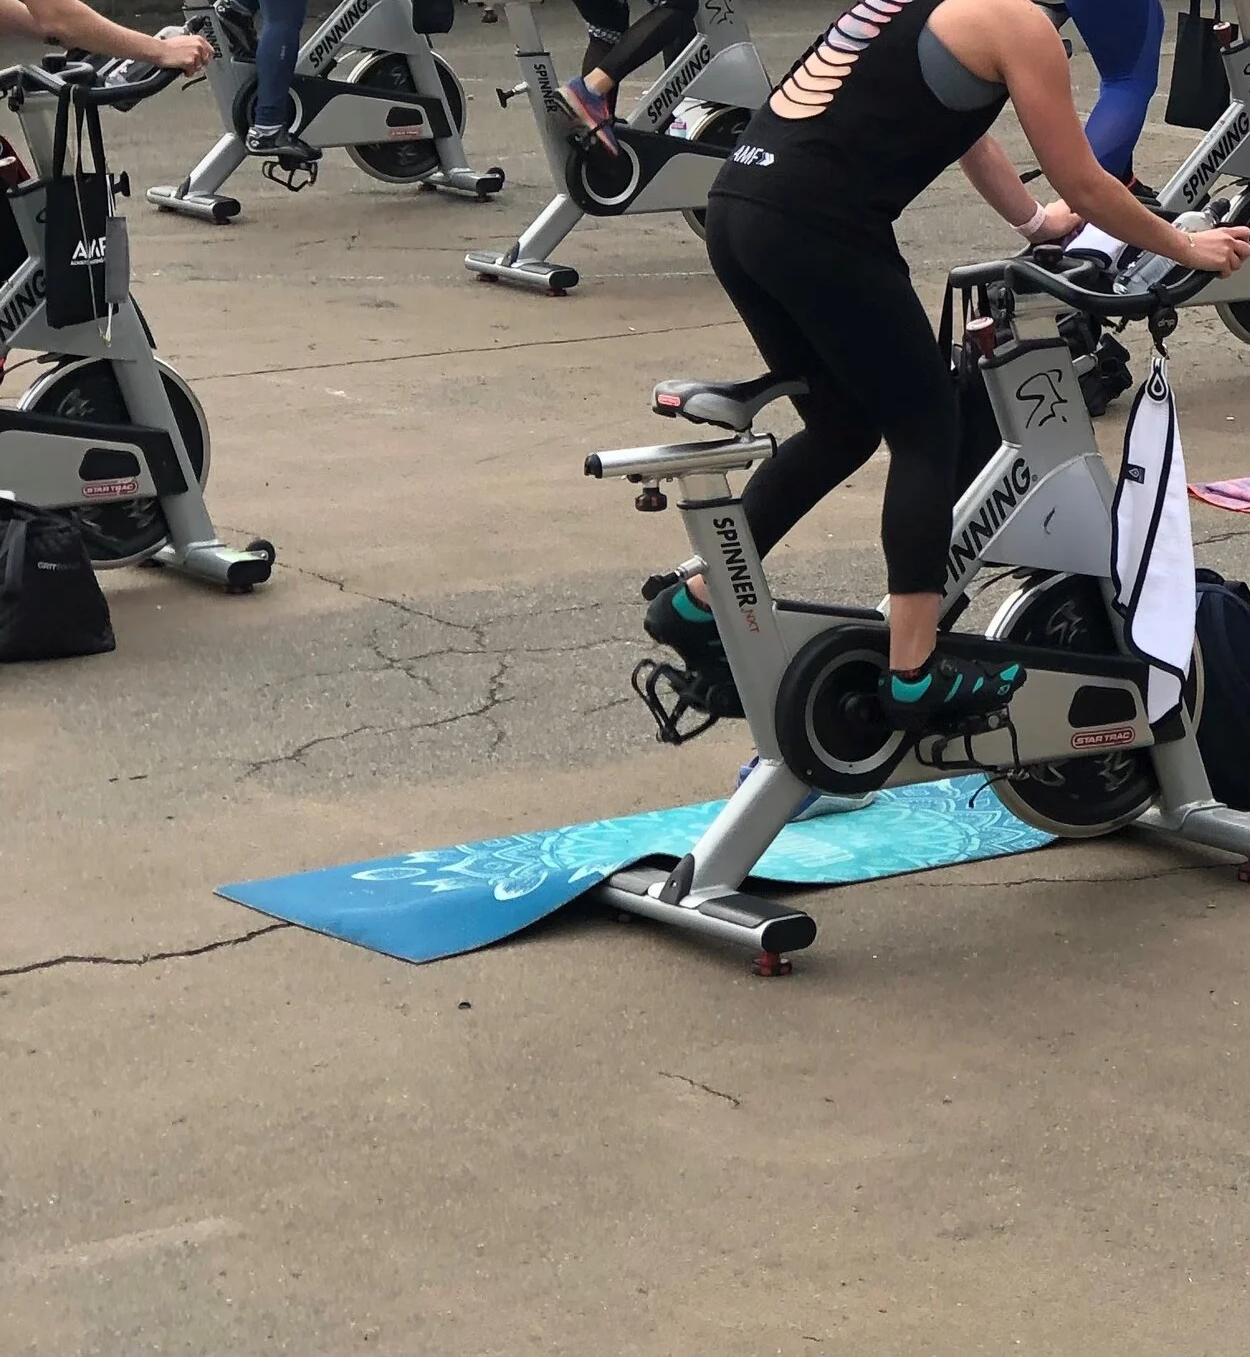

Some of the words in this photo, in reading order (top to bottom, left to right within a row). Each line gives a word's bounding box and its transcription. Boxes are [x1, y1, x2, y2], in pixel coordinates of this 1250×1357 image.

[534, 64, 558, 113] SPINNER
[647, 44, 711, 124] SPINNING
[1183, 112, 1250, 204] SPINNING
[0, 269, 46, 341] NING
[943, 458, 1031, 598] INNING
[713, 517, 758, 608] SPINNER
[744, 609, 760, 634] NXT
[1076, 735, 1103, 744] STAR
[1105, 732, 1130, 741] TRAC
